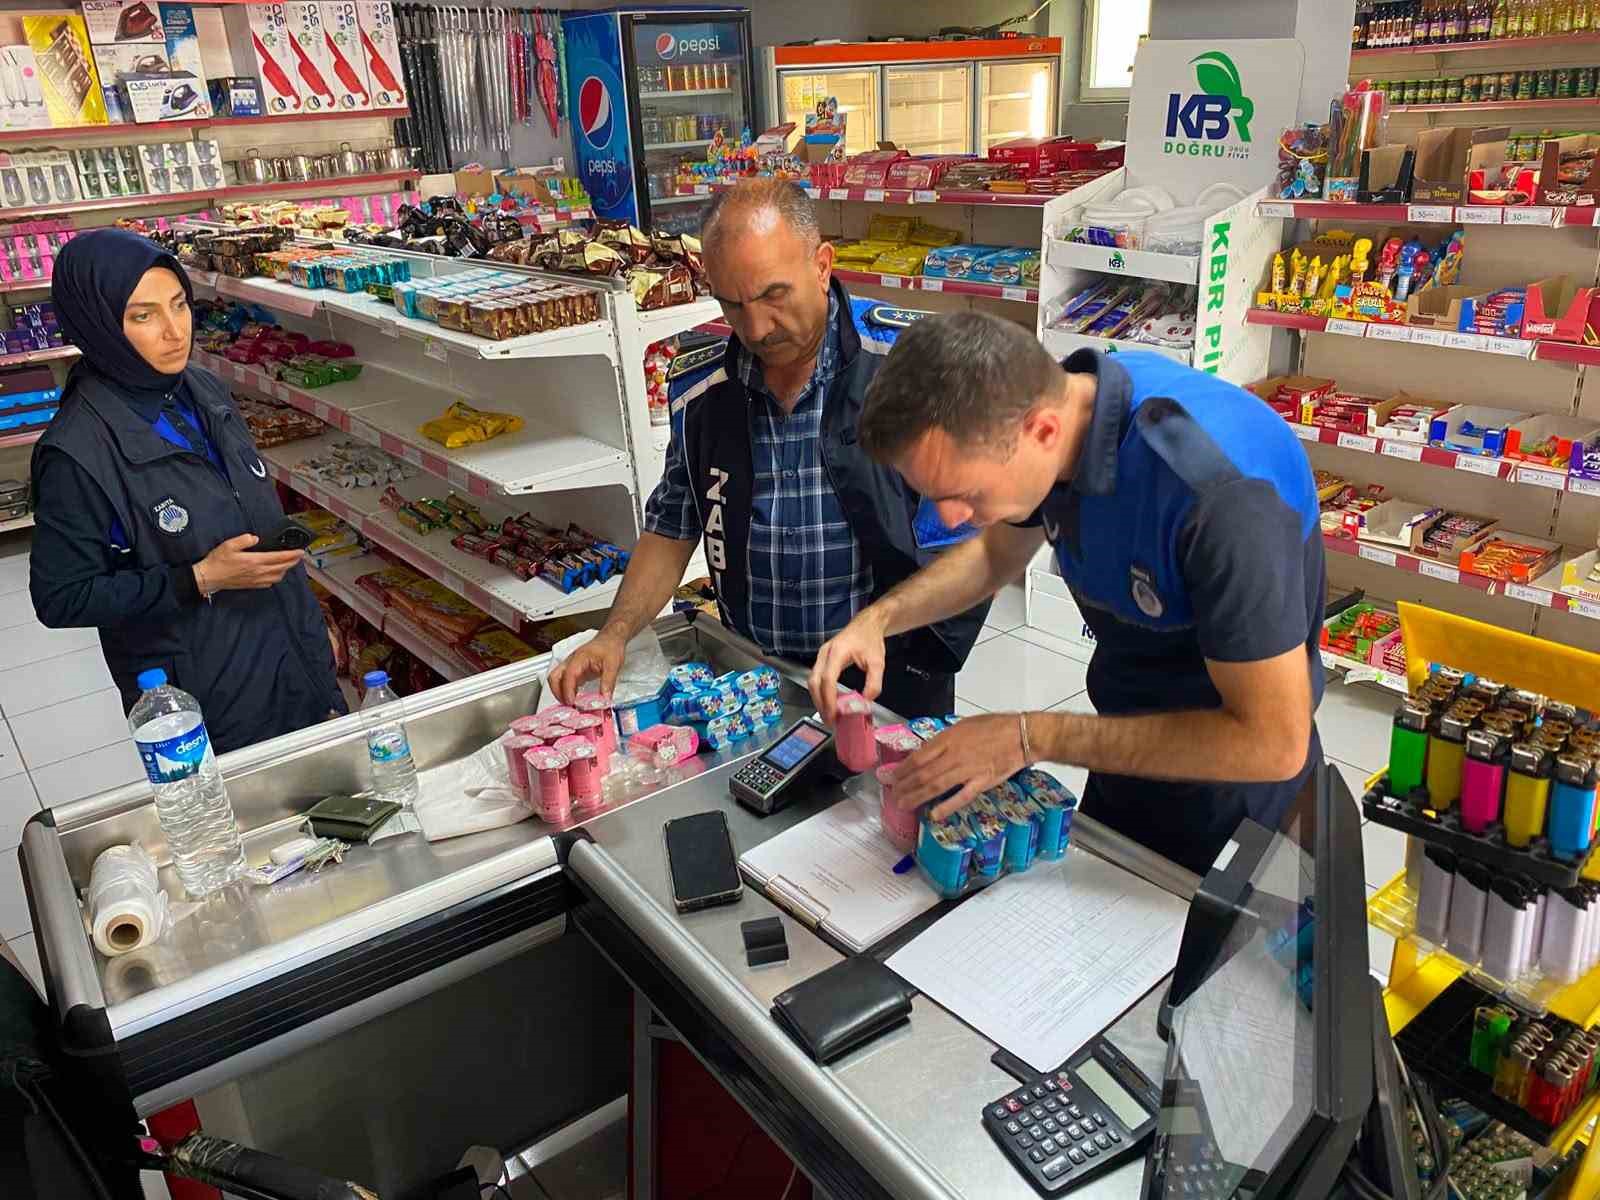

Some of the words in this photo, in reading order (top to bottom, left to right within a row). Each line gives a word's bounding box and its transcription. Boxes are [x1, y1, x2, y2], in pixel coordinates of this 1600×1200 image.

[679, 35, 720, 55] pepsi
[1165, 93, 1254, 142] KBR
[1164, 141, 1225, 157] DOĞRU
[588, 157, 617, 176] pepsi
[1208, 222, 1231, 312] KBR
